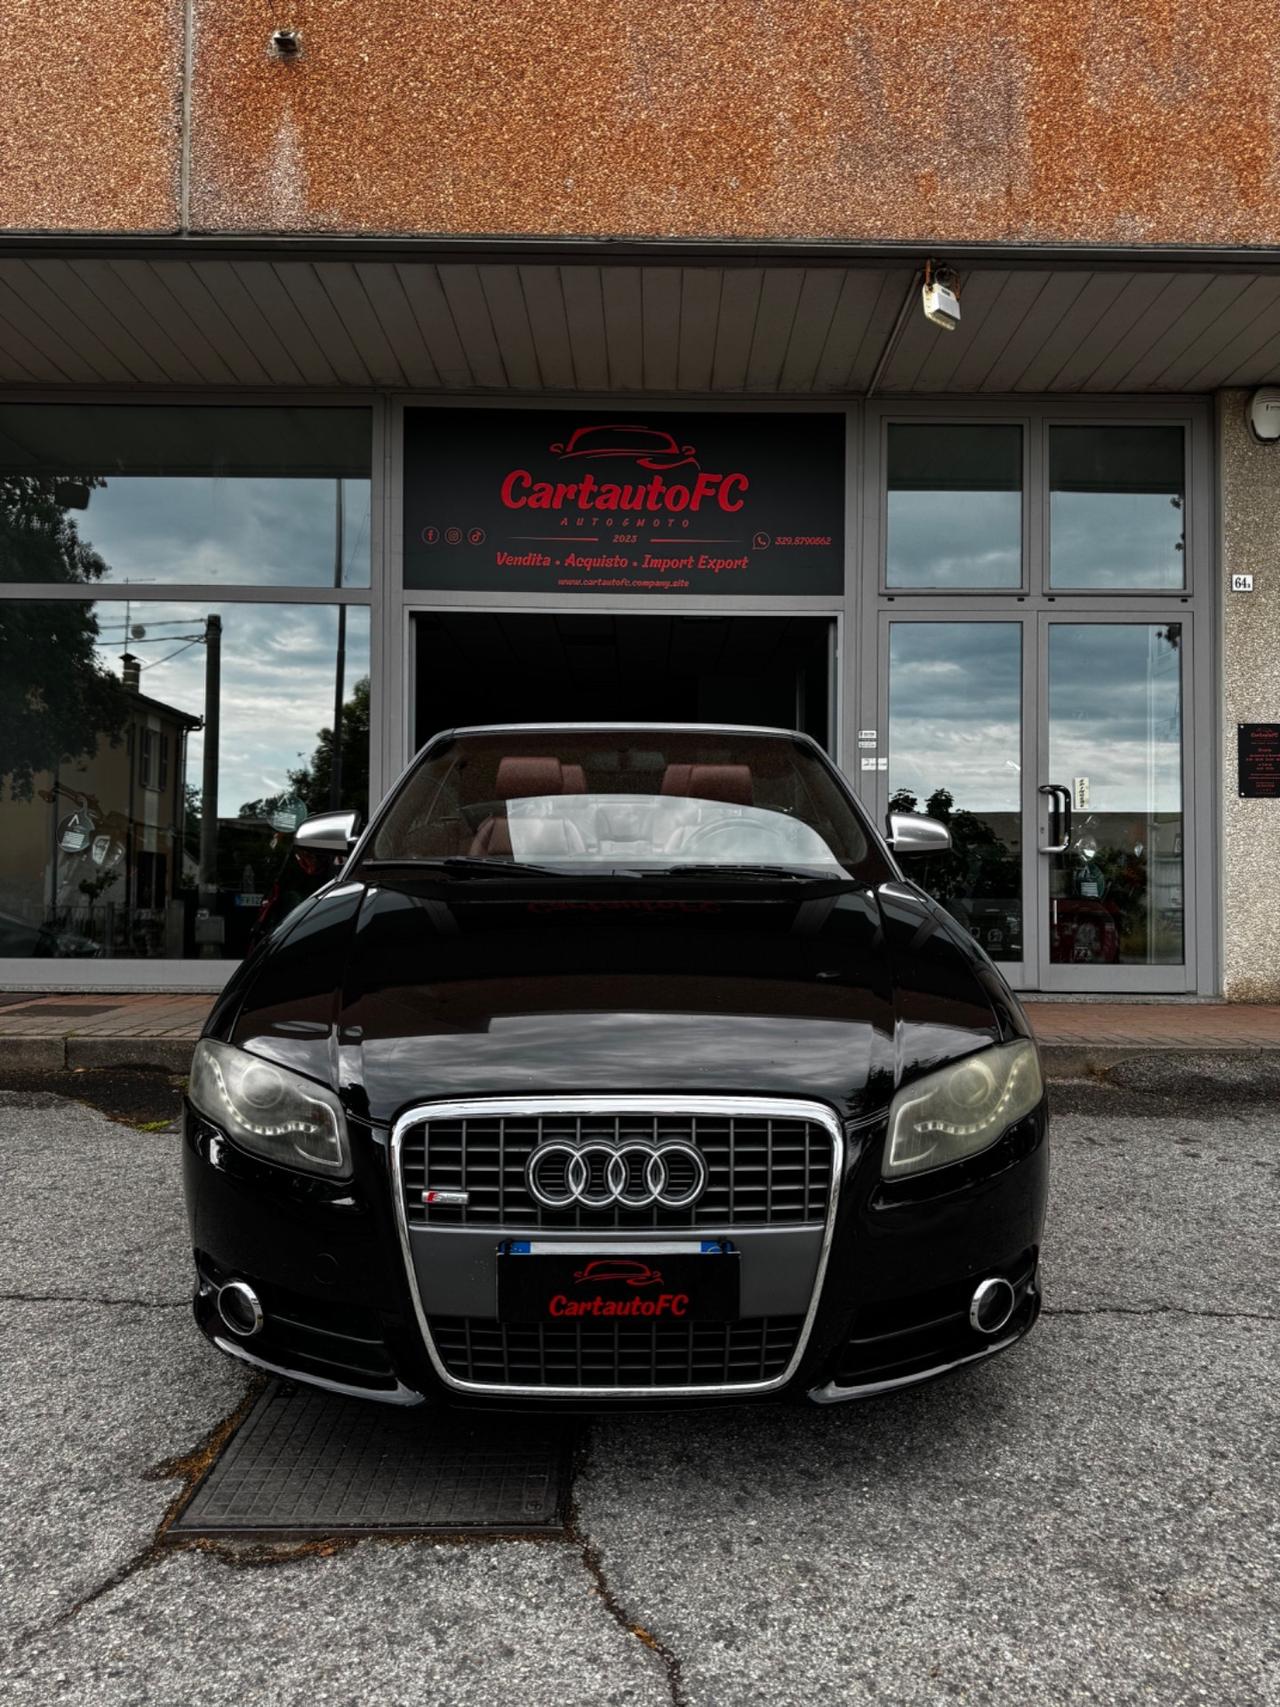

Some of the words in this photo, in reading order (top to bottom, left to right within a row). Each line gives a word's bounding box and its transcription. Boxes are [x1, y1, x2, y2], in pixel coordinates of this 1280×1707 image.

[501, 470, 749, 513] CartautoFC
[496, 551, 551, 567] Vendita
[564, 553, 629, 571] Acquisto
[641, 553, 694, 573] Import
[697, 554, 749, 574] Export
[548, 1294, 690, 1318] CartautoFC
